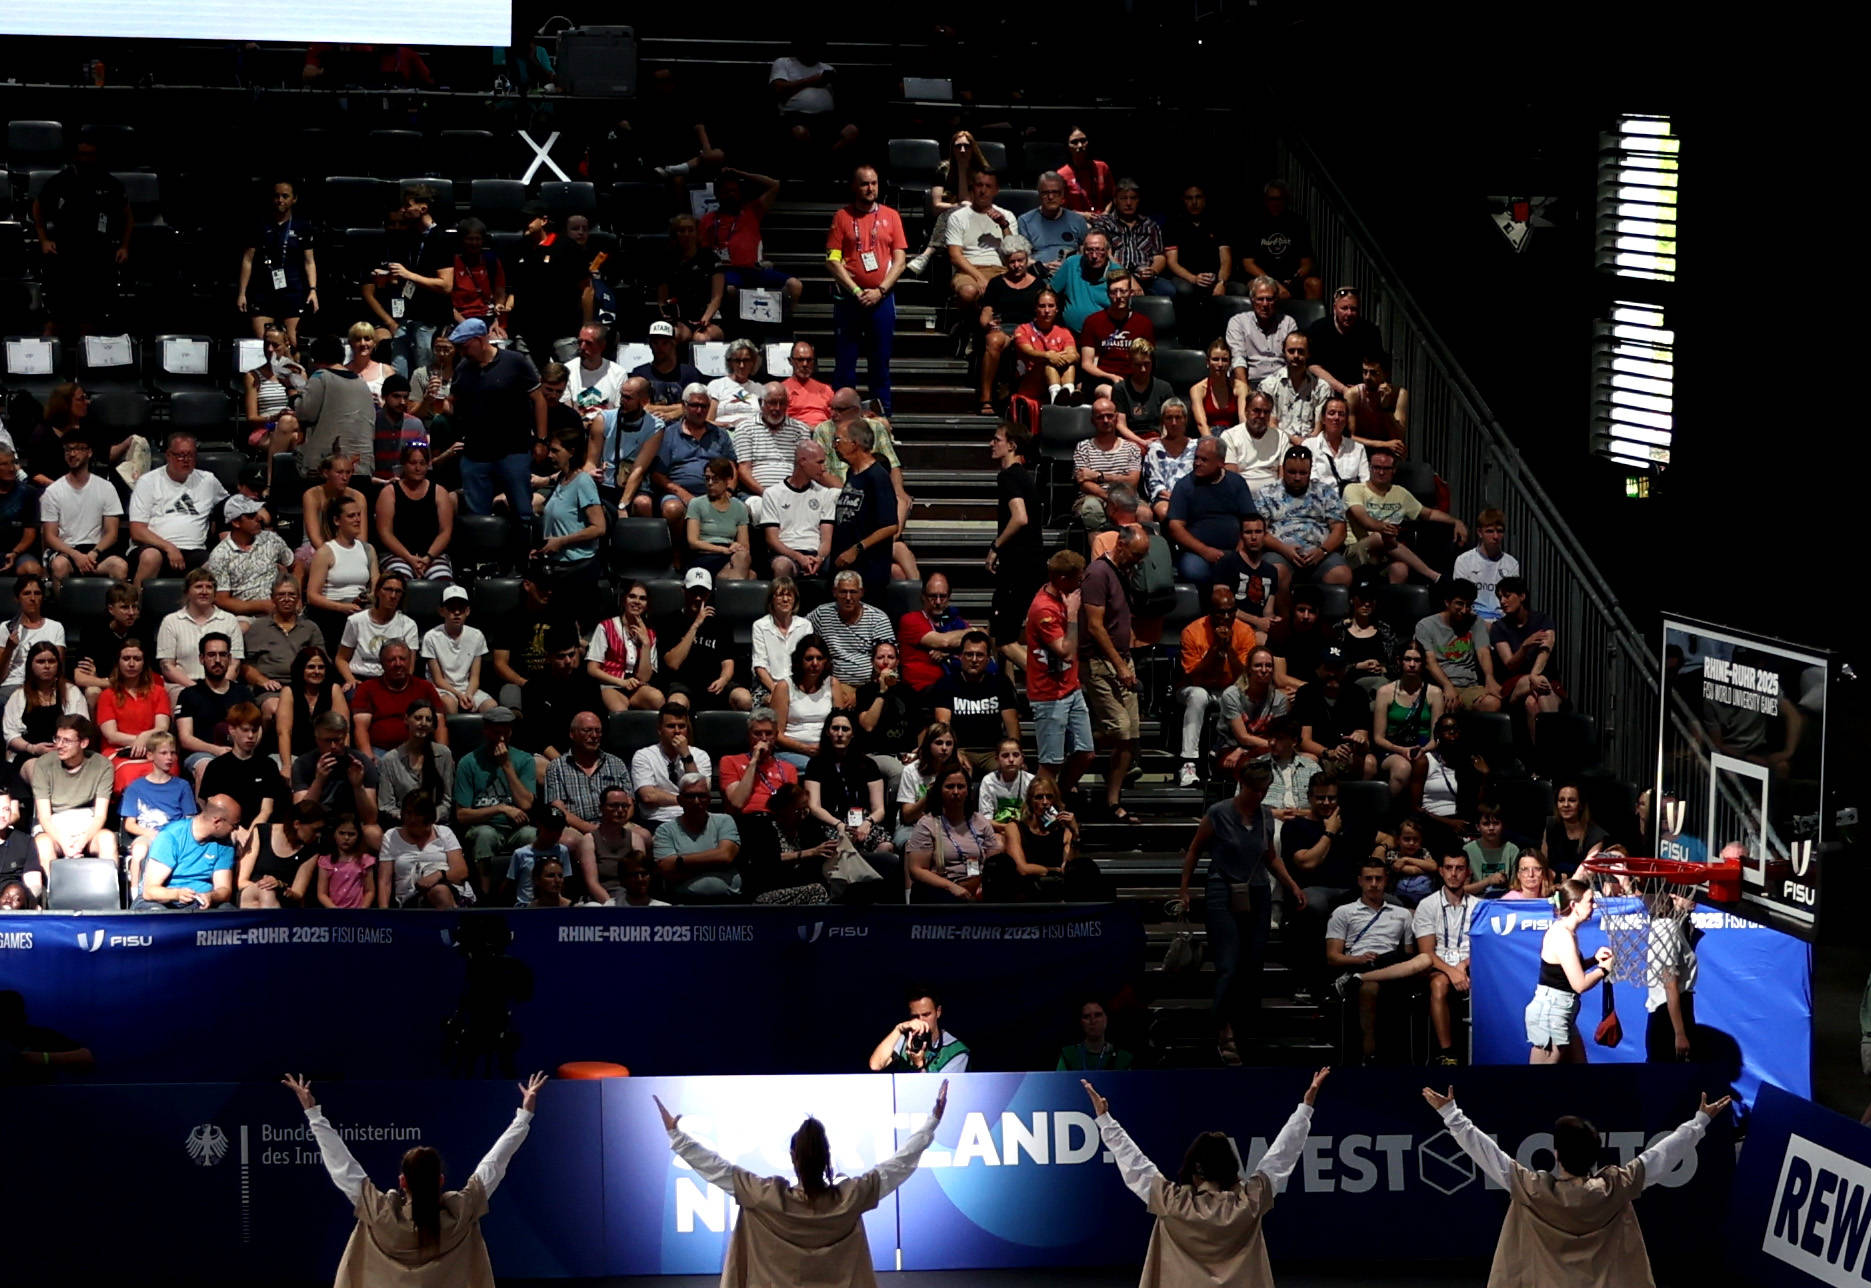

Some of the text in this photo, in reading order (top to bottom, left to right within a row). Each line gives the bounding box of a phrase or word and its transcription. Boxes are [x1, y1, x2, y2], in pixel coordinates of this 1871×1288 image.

[1704, 656, 1779, 696] RHINE-RUHR 2025
[953, 695, 1000, 711] WINGS
[1714, 683, 1732, 705] WORLD
[1732, 687, 1761, 713] UNIVERSITY
[1761, 694, 1778, 717] GAMES
[1659, 839, 1689, 862] FISU
[1784, 880, 1816, 907] FISU
[196, 926, 393, 946] RHINE-RUHR 2025 FISU GAMES
[558, 925, 754, 943] RHINE-RUHR 2025 FISU GAMES
[828, 926, 870, 938] FISU
[910, 923, 1001, 941] RHINE-RUHR
[1041, 922, 1065, 940] FISU
[1066, 920, 1103, 938] GAMES
[109, 934, 153, 947] FISU
[261, 1124, 422, 1143] Bundeinisterium
[261, 1148, 291, 1165] des
